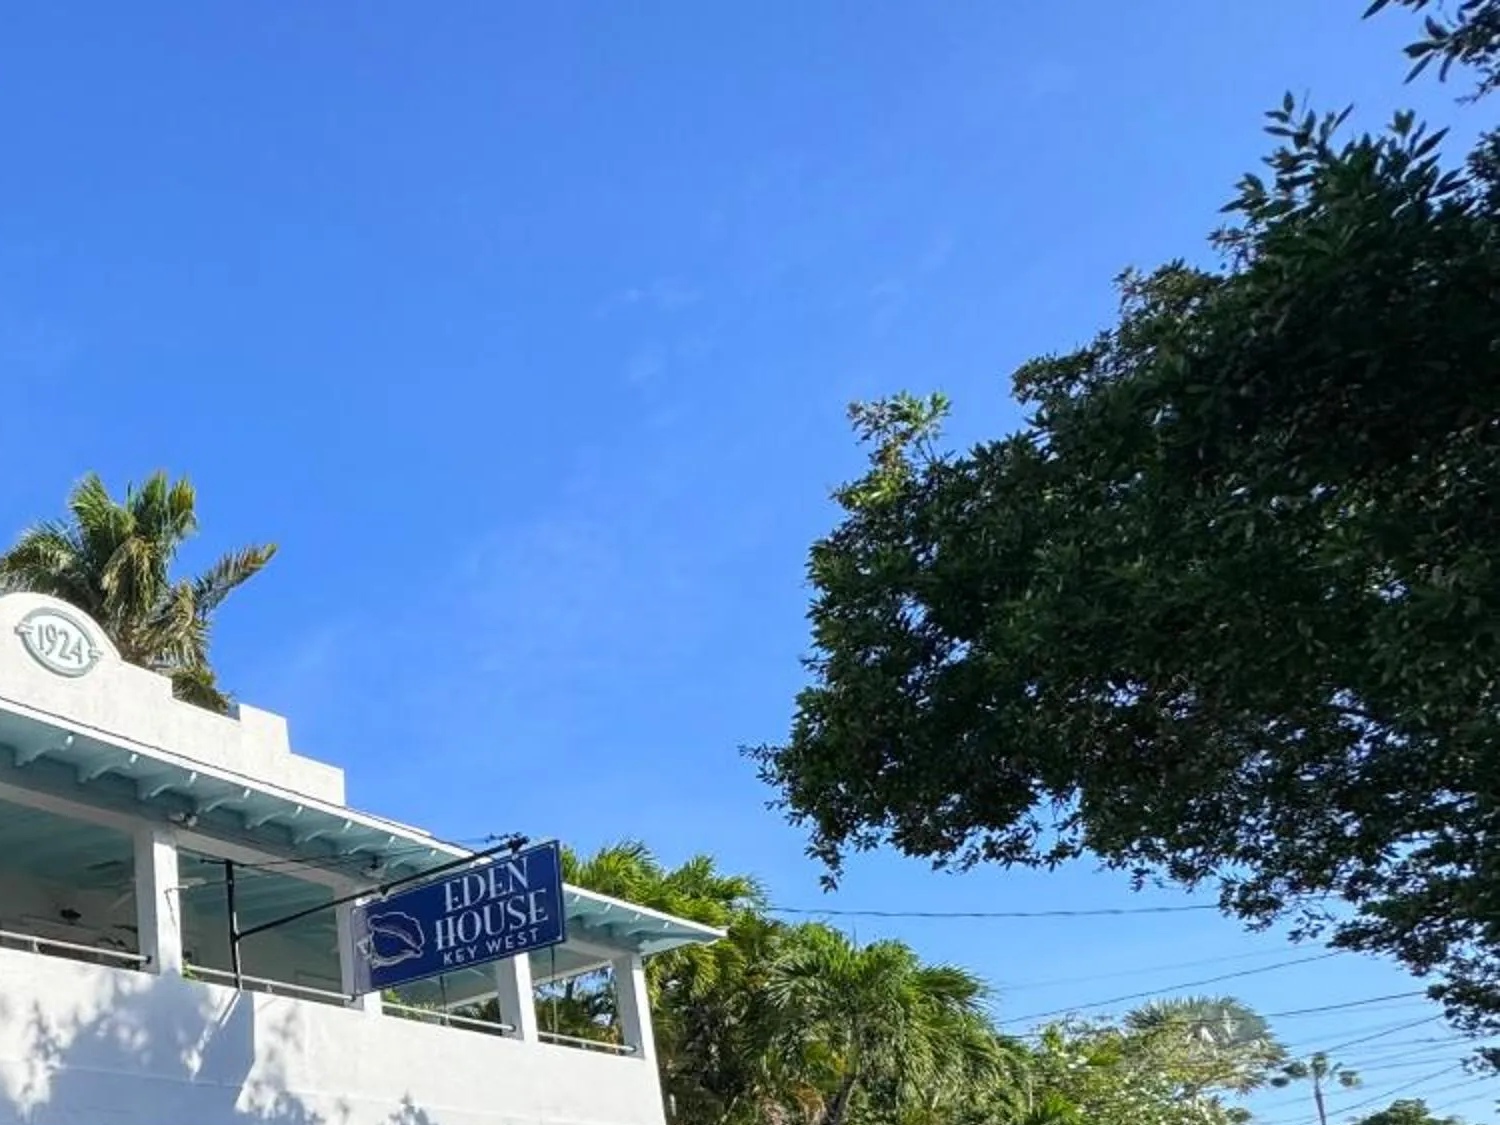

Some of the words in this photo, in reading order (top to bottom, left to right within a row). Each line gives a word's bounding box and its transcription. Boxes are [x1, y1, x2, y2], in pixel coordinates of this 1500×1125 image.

[38, 624, 83, 664] 1924
[444, 857, 529, 912] EDEN
[435, 889, 548, 950] HOUSE
[443, 945, 477, 965] KEY
[485, 928, 538, 954] WEST
